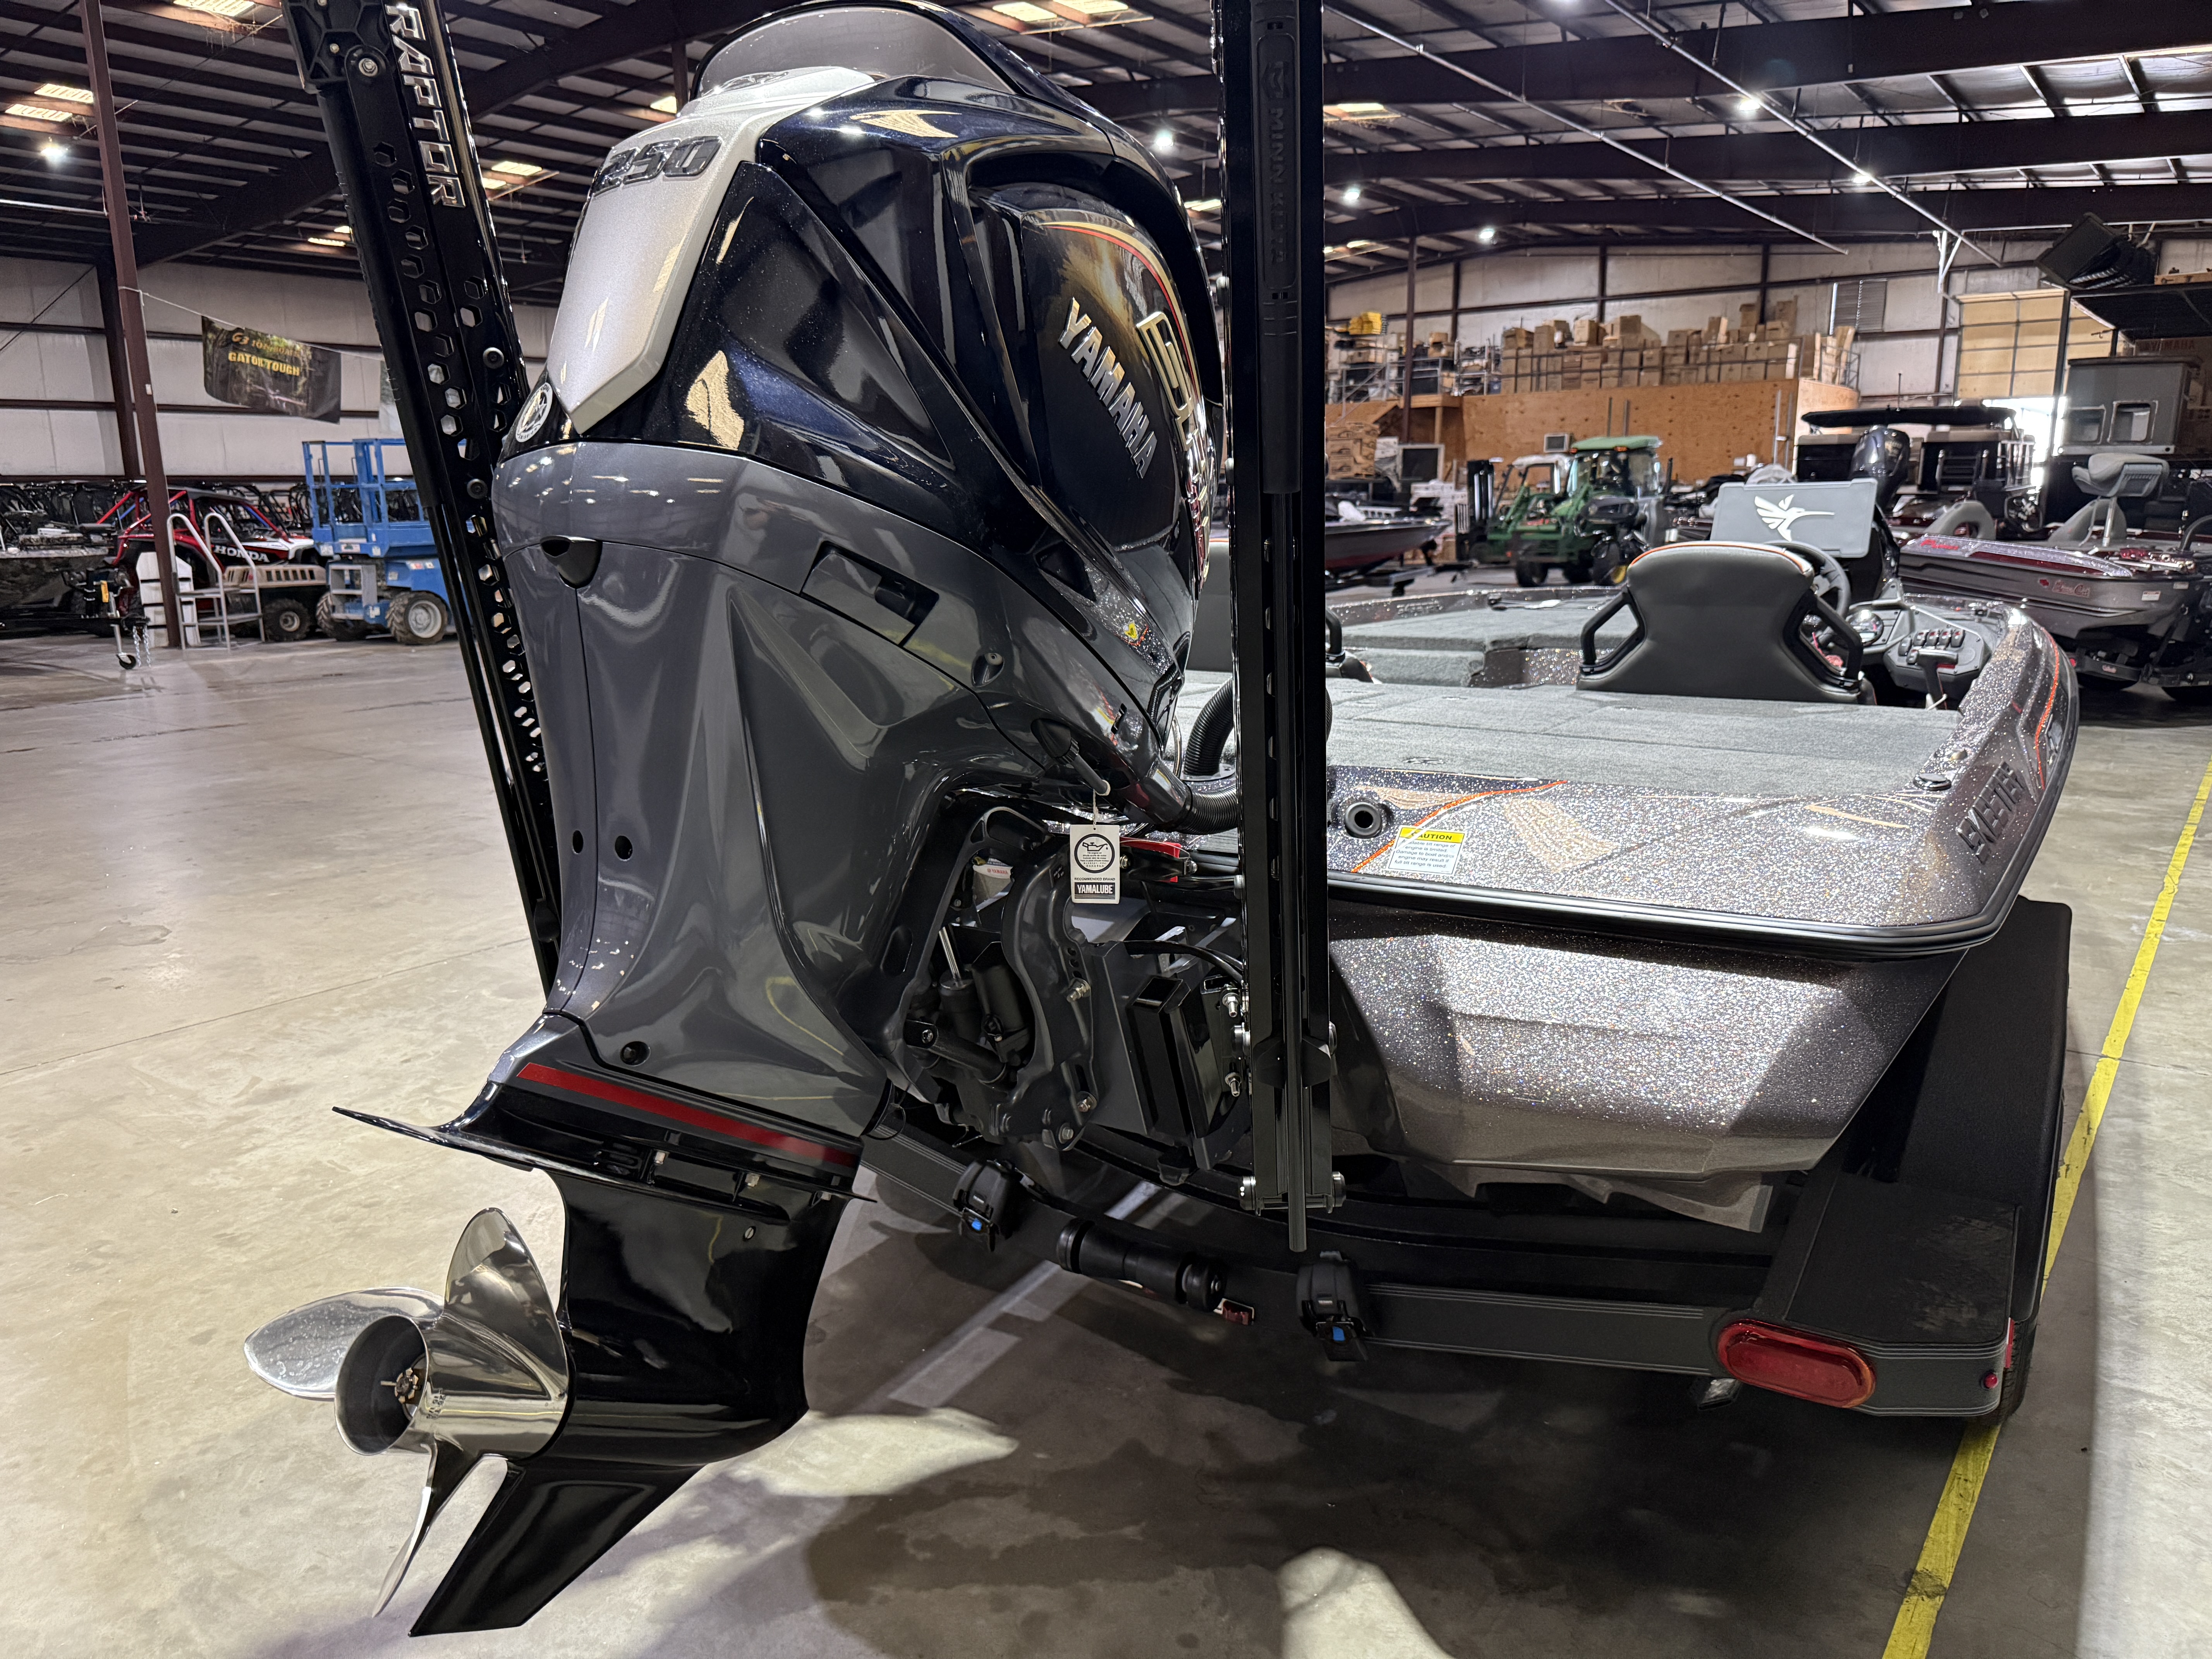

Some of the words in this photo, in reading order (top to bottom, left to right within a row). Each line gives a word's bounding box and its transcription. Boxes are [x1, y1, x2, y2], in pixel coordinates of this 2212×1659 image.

[385, 4, 465, 207] RAPTOR
[1269, 108, 1285, 184] MINN
[232, 332, 250, 345] G3
[228, 351, 264, 368] GATOR
[266, 359, 300, 376] TOUGH
[1058, 297, 1157, 479] YAMAHA
[213, 544, 270, 563] HONDA
[1077, 884, 1113, 894] YAMALUBE
